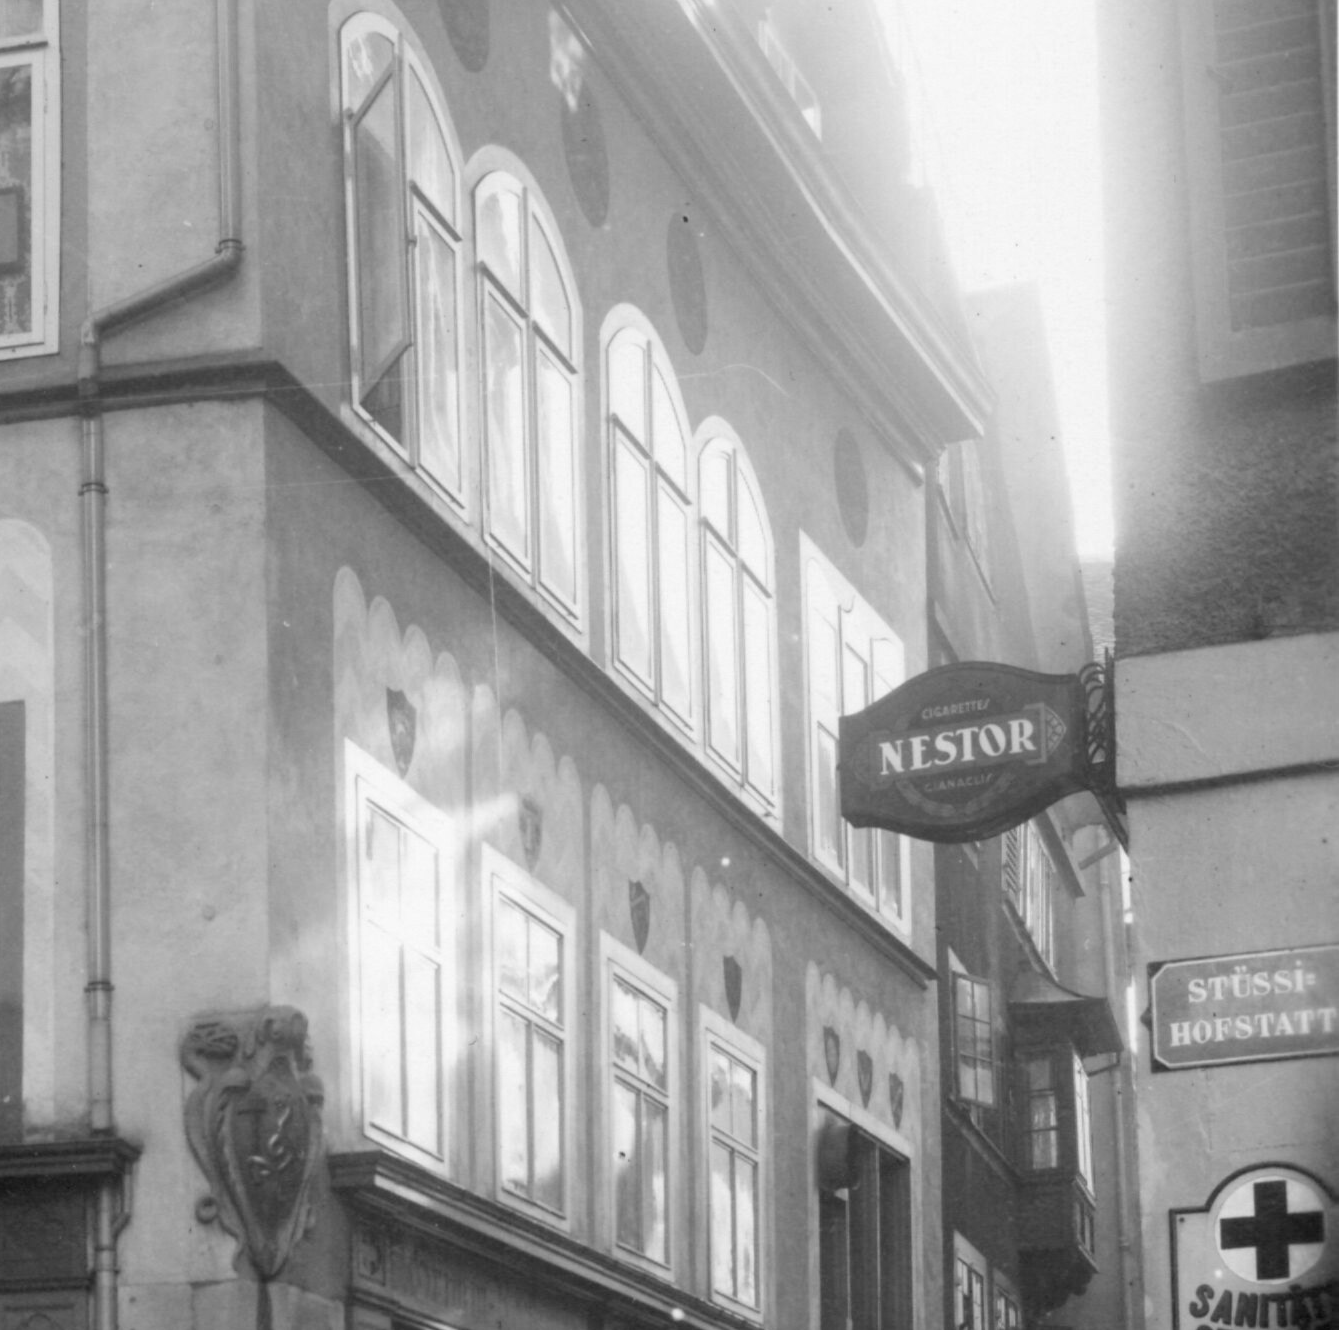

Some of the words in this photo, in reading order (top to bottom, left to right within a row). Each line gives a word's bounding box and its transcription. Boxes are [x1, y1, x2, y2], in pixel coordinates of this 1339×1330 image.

[921, 698, 990, 720] CIGARETTES
[878, 718, 1037, 776] NESTOR
[1169, 1007, 1337, 1047] HOFSTATT
